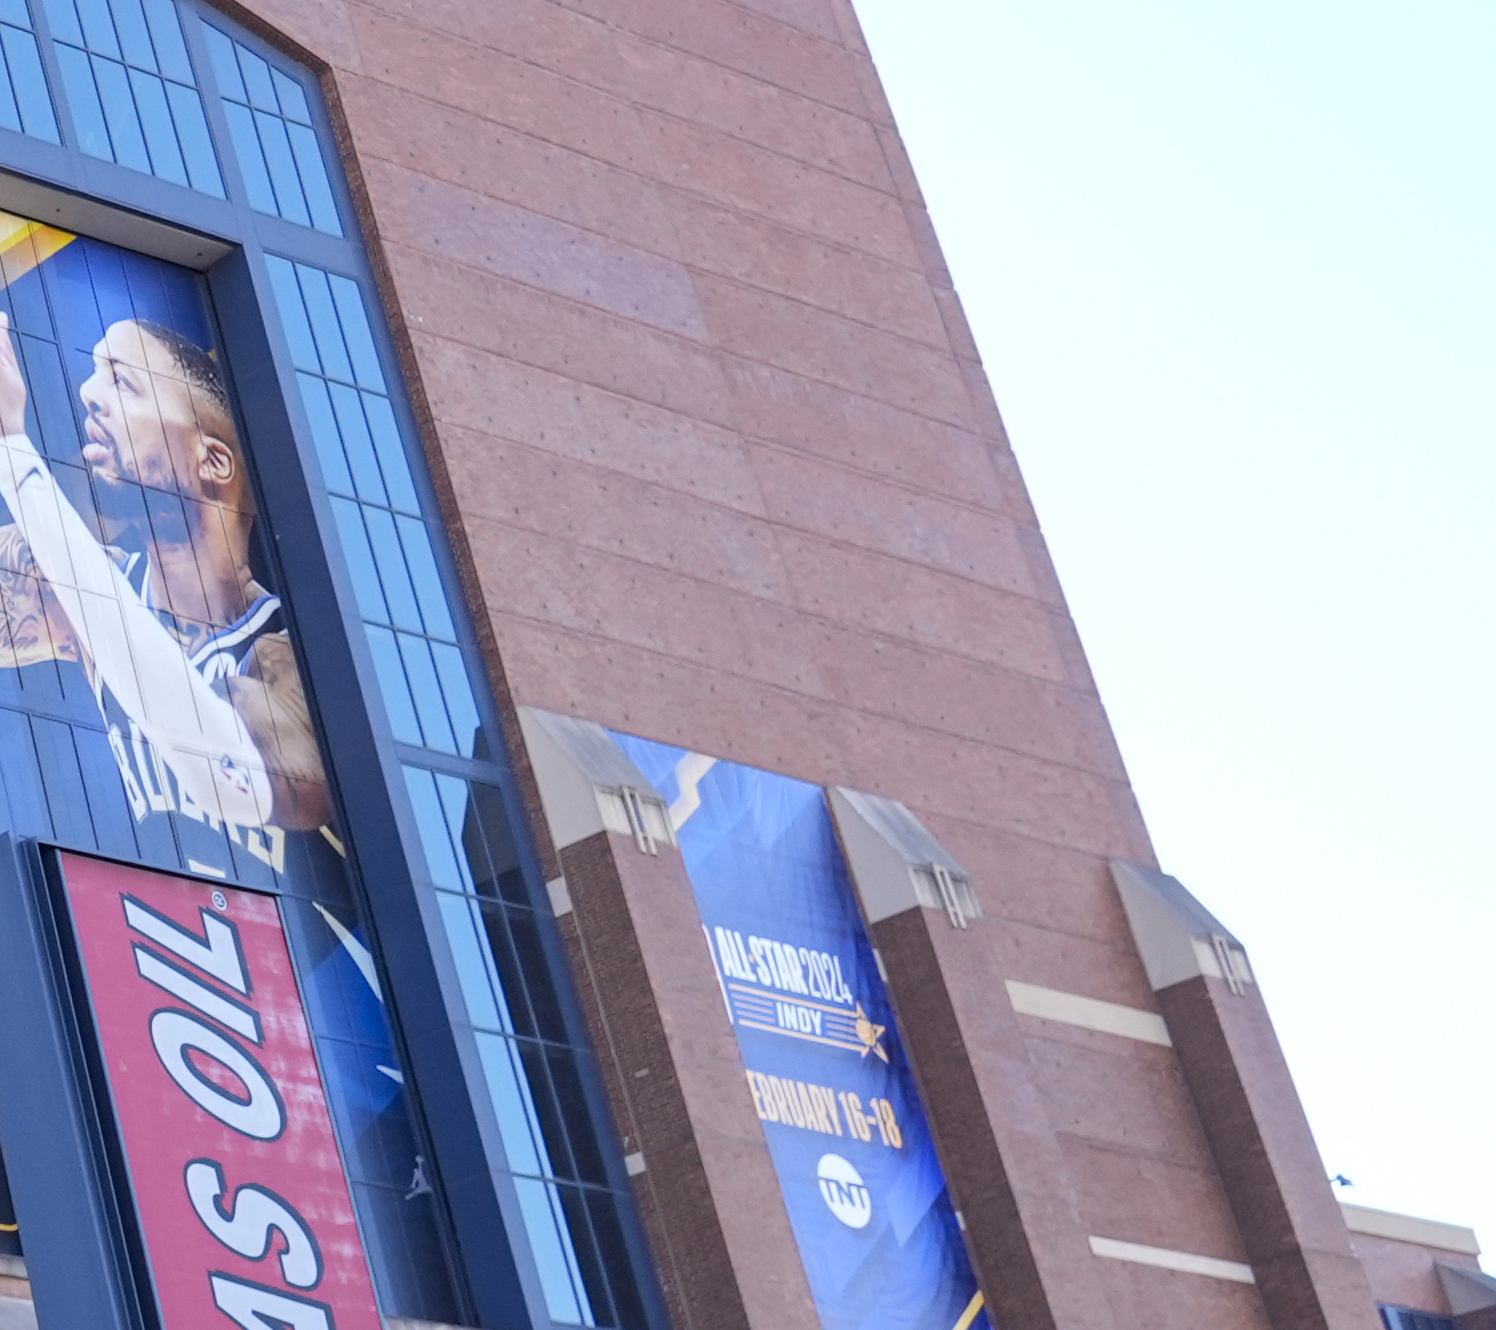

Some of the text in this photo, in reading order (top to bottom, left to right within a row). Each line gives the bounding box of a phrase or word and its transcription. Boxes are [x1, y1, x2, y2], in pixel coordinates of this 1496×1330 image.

[798, 946, 854, 1006] 2024
[120, 890, 288, 1144] OIL
[775, 1001, 823, 1037] INDY
[837, 1089, 903, 1149] 16-18
